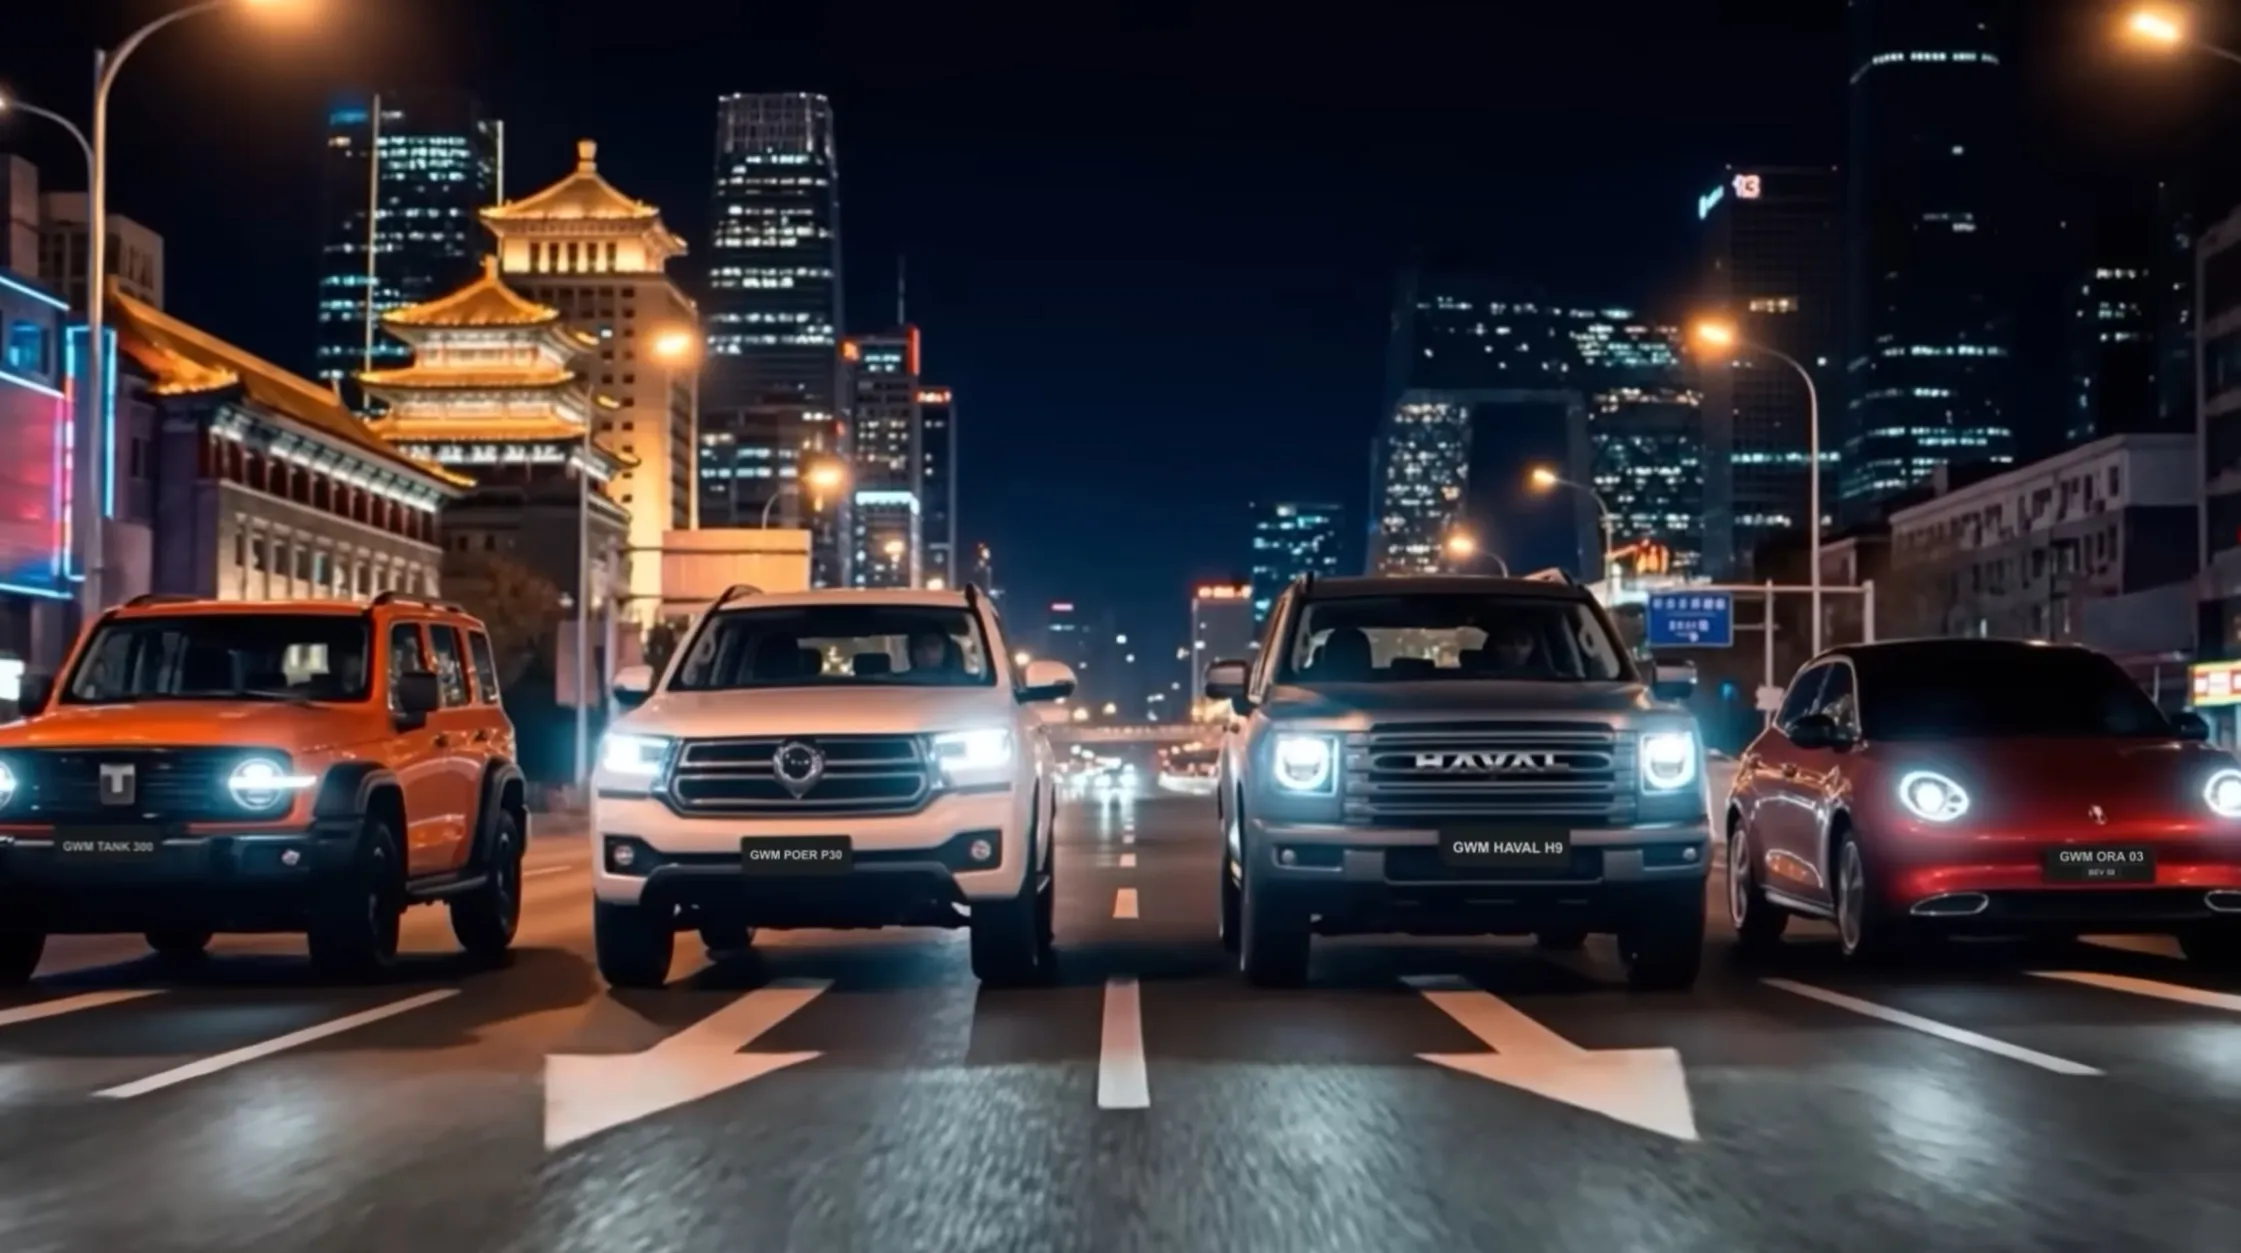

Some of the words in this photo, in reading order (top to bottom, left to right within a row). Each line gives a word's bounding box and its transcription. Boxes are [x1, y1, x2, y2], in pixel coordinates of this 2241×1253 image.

[1416, 753, 1569, 773] HAVAL
[62, 841, 94, 852] GWM
[97, 841, 131, 852] TANK
[132, 841, 154, 852] 300
[1453, 841, 1490, 853] GWM
[1493, 841, 1541, 853] HAVAL
[1544, 841, 1564, 853] H9
[749, 849, 781, 860] GWM
[783, 849, 818, 860] POER
[820, 849, 843, 860] P30
[2059, 851, 2093, 862] GWM
[2096, 851, 2126, 862] ORA
[2128, 851, 2144, 862] 03
